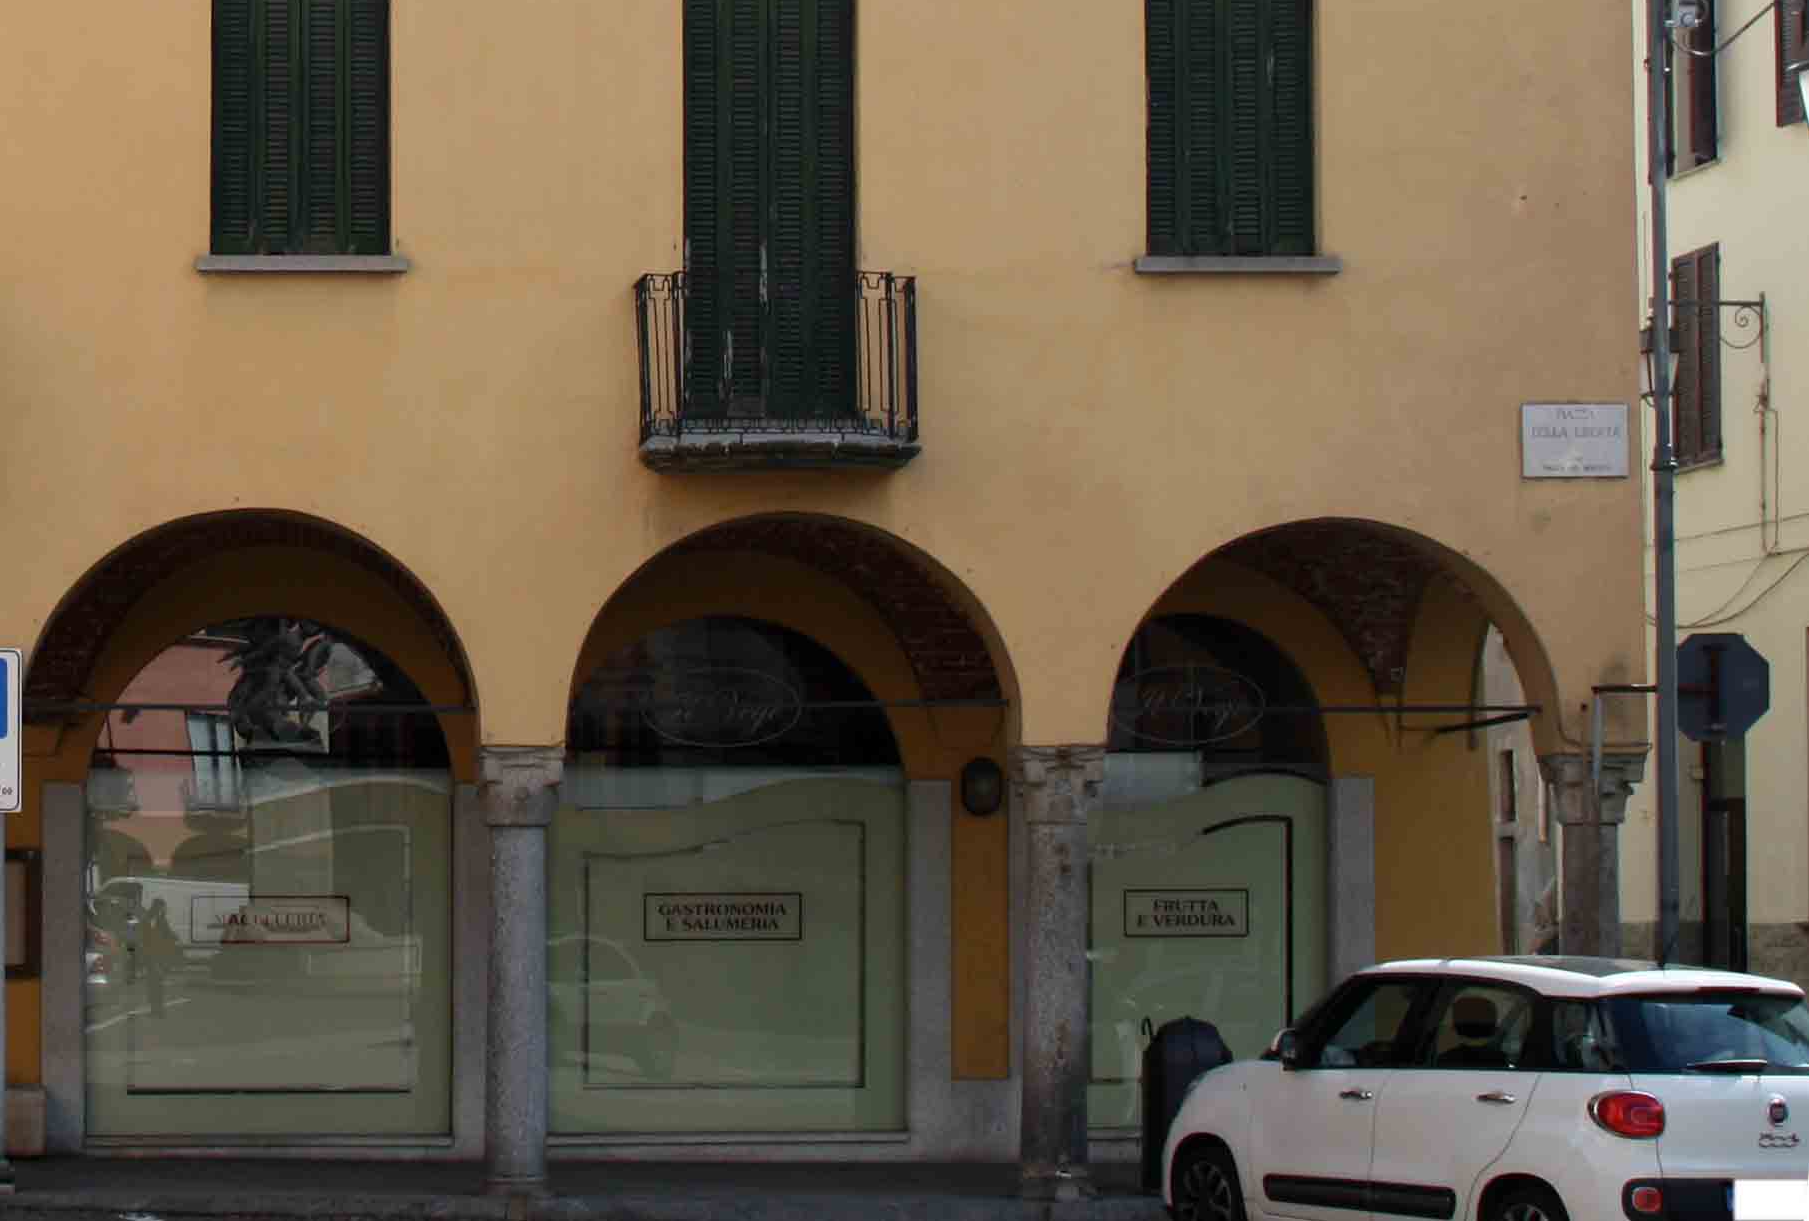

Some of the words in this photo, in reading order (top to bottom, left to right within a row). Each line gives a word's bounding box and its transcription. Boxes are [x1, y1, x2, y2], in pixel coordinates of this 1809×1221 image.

[657, 902, 787, 916] GASTRONOMIA
[1152, 898, 1219, 912] FRUTTA
[666, 917, 677, 931] E
[681, 917, 780, 931] SALUMERIA
[1136, 914, 1147, 927] E
[1151, 913, 1236, 927] VERDURA
